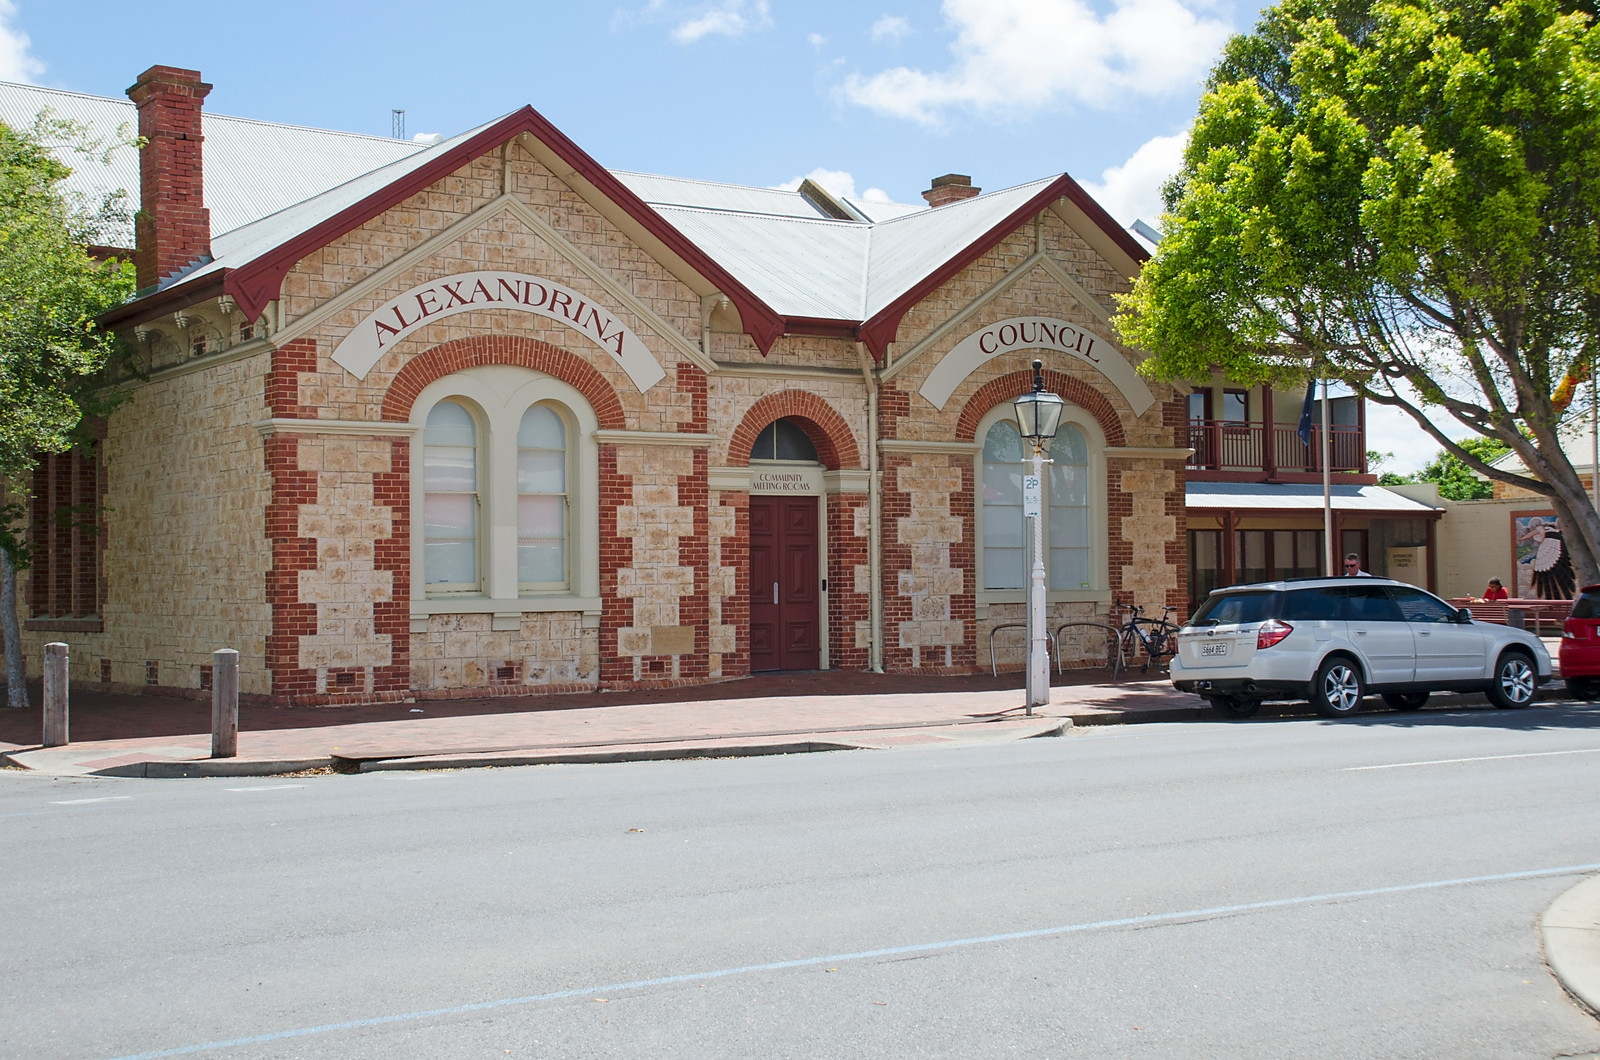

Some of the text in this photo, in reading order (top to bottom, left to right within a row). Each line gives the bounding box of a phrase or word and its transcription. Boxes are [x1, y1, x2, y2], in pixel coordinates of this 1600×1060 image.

[370, 278, 625, 357] ALEXANDRINA
[979, 322, 1100, 363] COUNCIL
[759, 474, 803, 482] COMMUNITY
[753, 482, 810, 491] MEETING ROOMS
[1026, 479, 1039, 490] 2P
